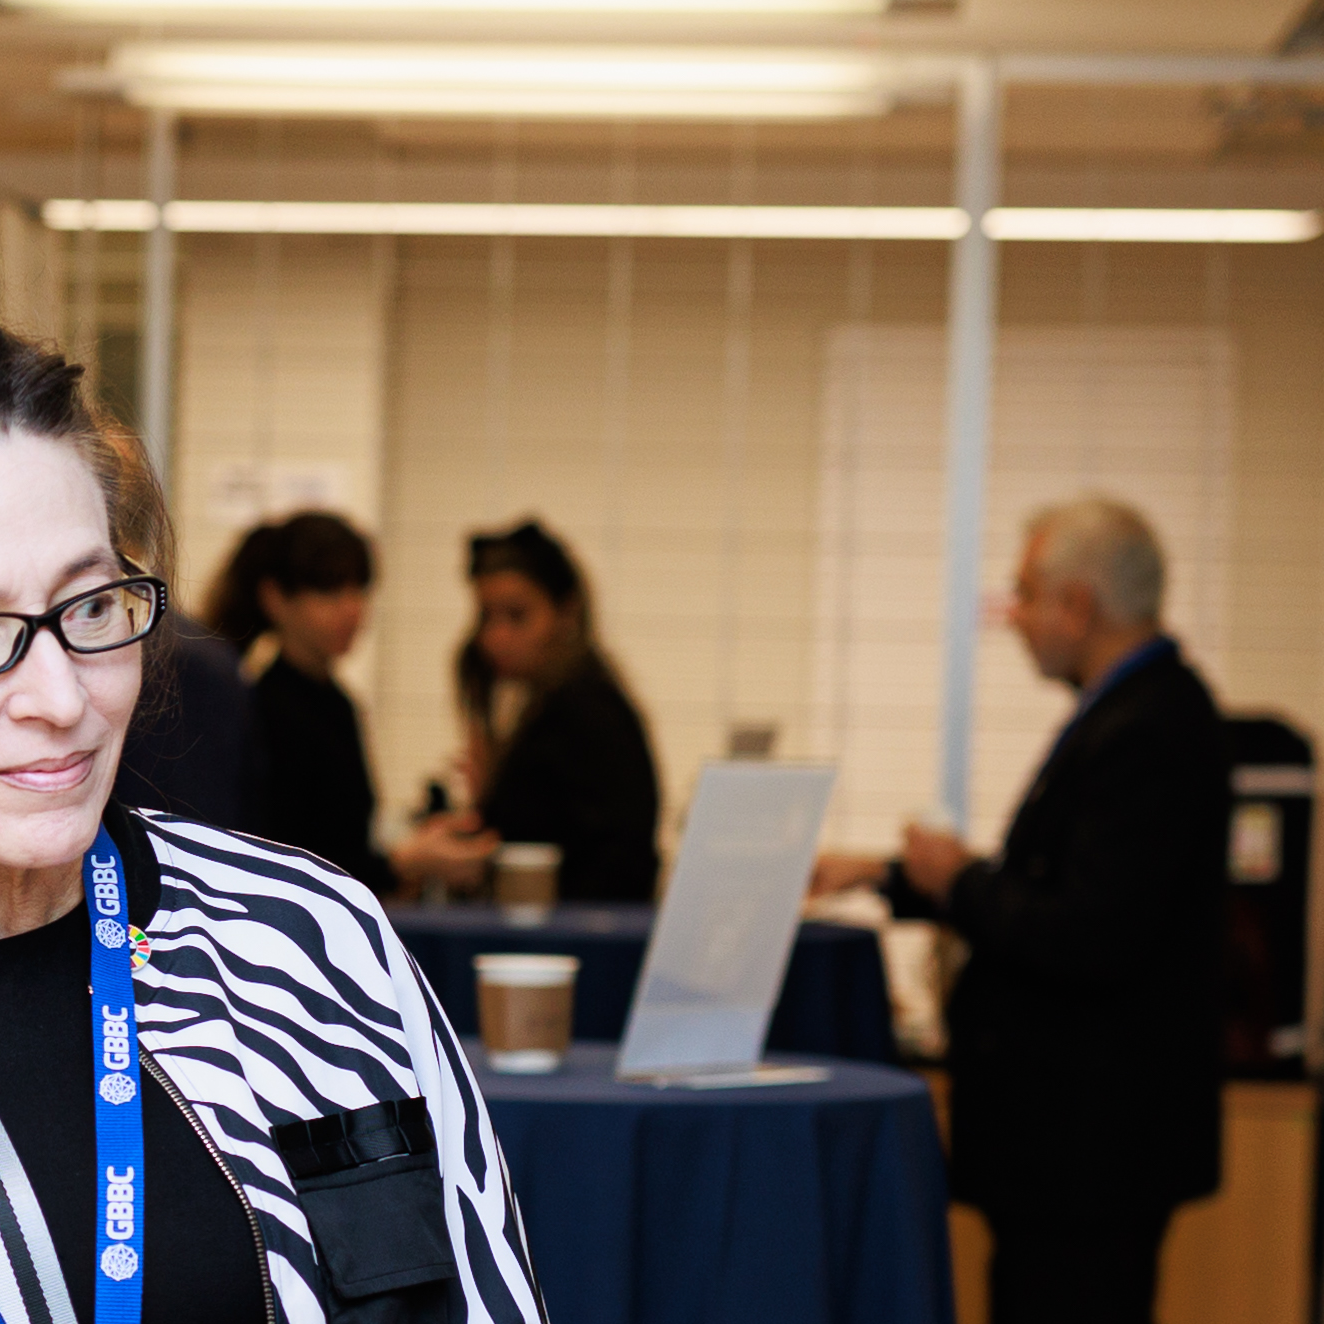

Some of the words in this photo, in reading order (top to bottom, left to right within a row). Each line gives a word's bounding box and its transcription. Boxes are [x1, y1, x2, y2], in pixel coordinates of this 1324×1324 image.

[91, 854, 120, 916] GBBC
[102, 1005, 130, 1071] GBBC
[106, 1165, 135, 1241] GBBC
